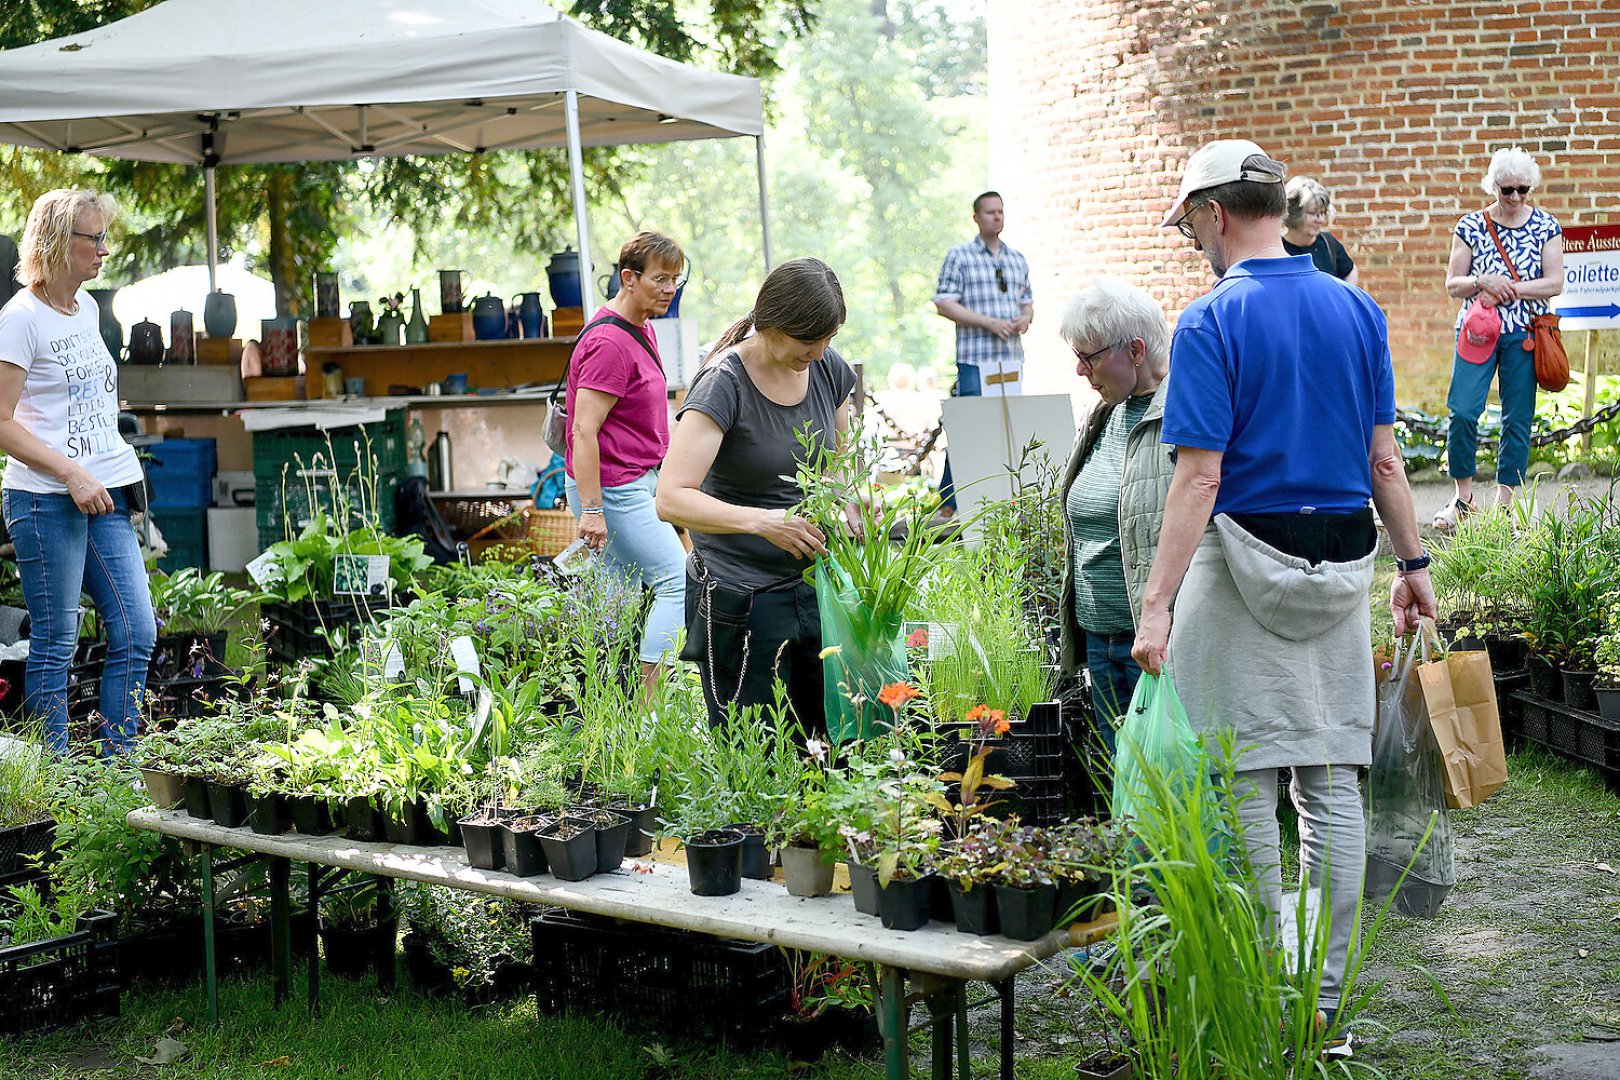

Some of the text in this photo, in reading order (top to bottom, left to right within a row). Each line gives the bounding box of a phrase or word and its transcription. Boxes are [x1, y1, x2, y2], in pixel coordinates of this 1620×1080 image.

[1563, 264, 1619, 283] oilette
[57, 353, 77, 367] DO
[104, 364, 117, 393] &
[68, 412, 102, 435] BEST
